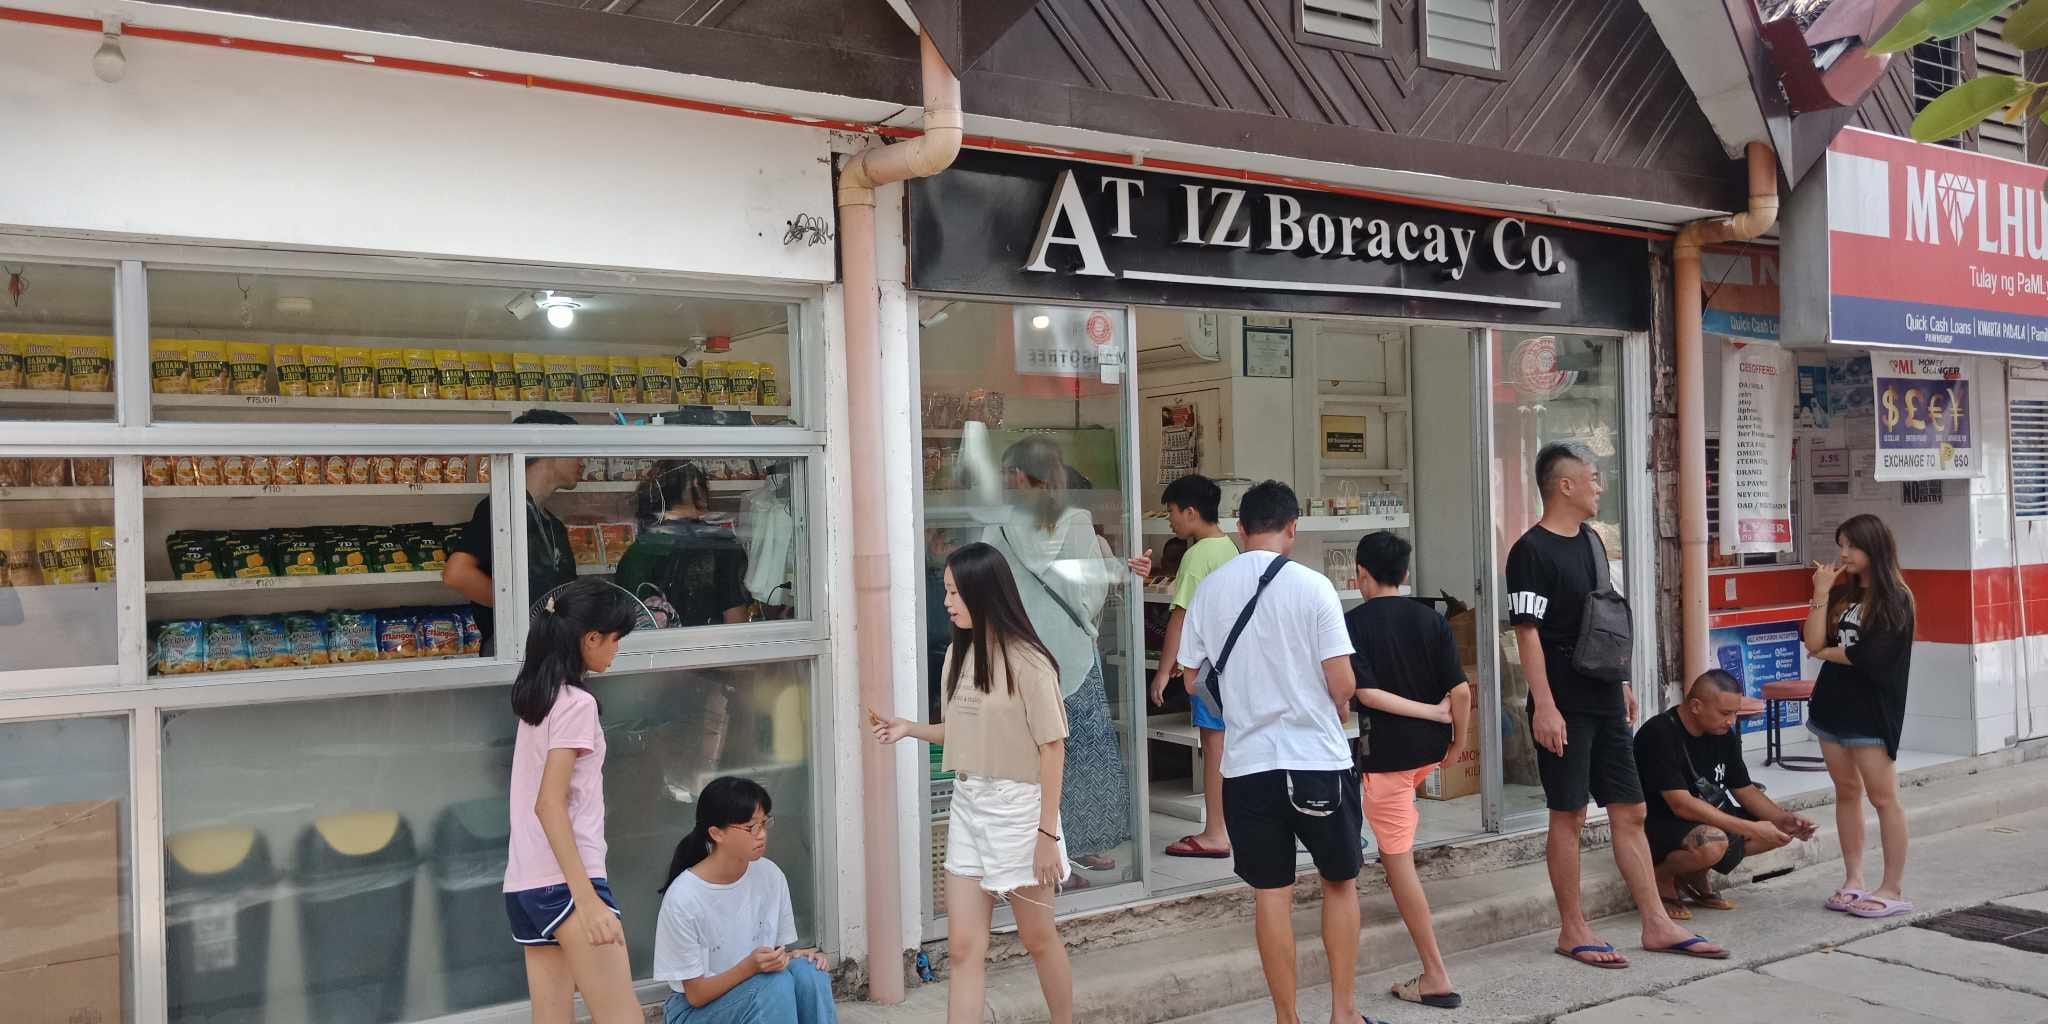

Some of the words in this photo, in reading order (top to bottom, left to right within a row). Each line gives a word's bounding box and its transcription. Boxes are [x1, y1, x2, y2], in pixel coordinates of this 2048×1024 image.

[1018, 168, 1145, 278] AT
[1178, 183, 1252, 248] IZ
[1262, 192, 1477, 281] Boracay
[1492, 217, 1568, 274] Co.
[1969, 265, 1998, 295] Tulay
[2001, 276, 2015, 297] ng
[1751, 317, 1770, 334] Cash
[1905, 313, 1927, 331] Quick
[1930, 315, 1948, 333] Cash
[1950, 317, 1972, 335] Loans
[1919, 358, 1944, 367] MONEY
[343, 367, 369, 375] BANANA
[1922, 366, 1961, 376] CHANGER
[1883, 453, 1925, 468] EXCHANGE
[1926, 454, 1936, 467] TO
